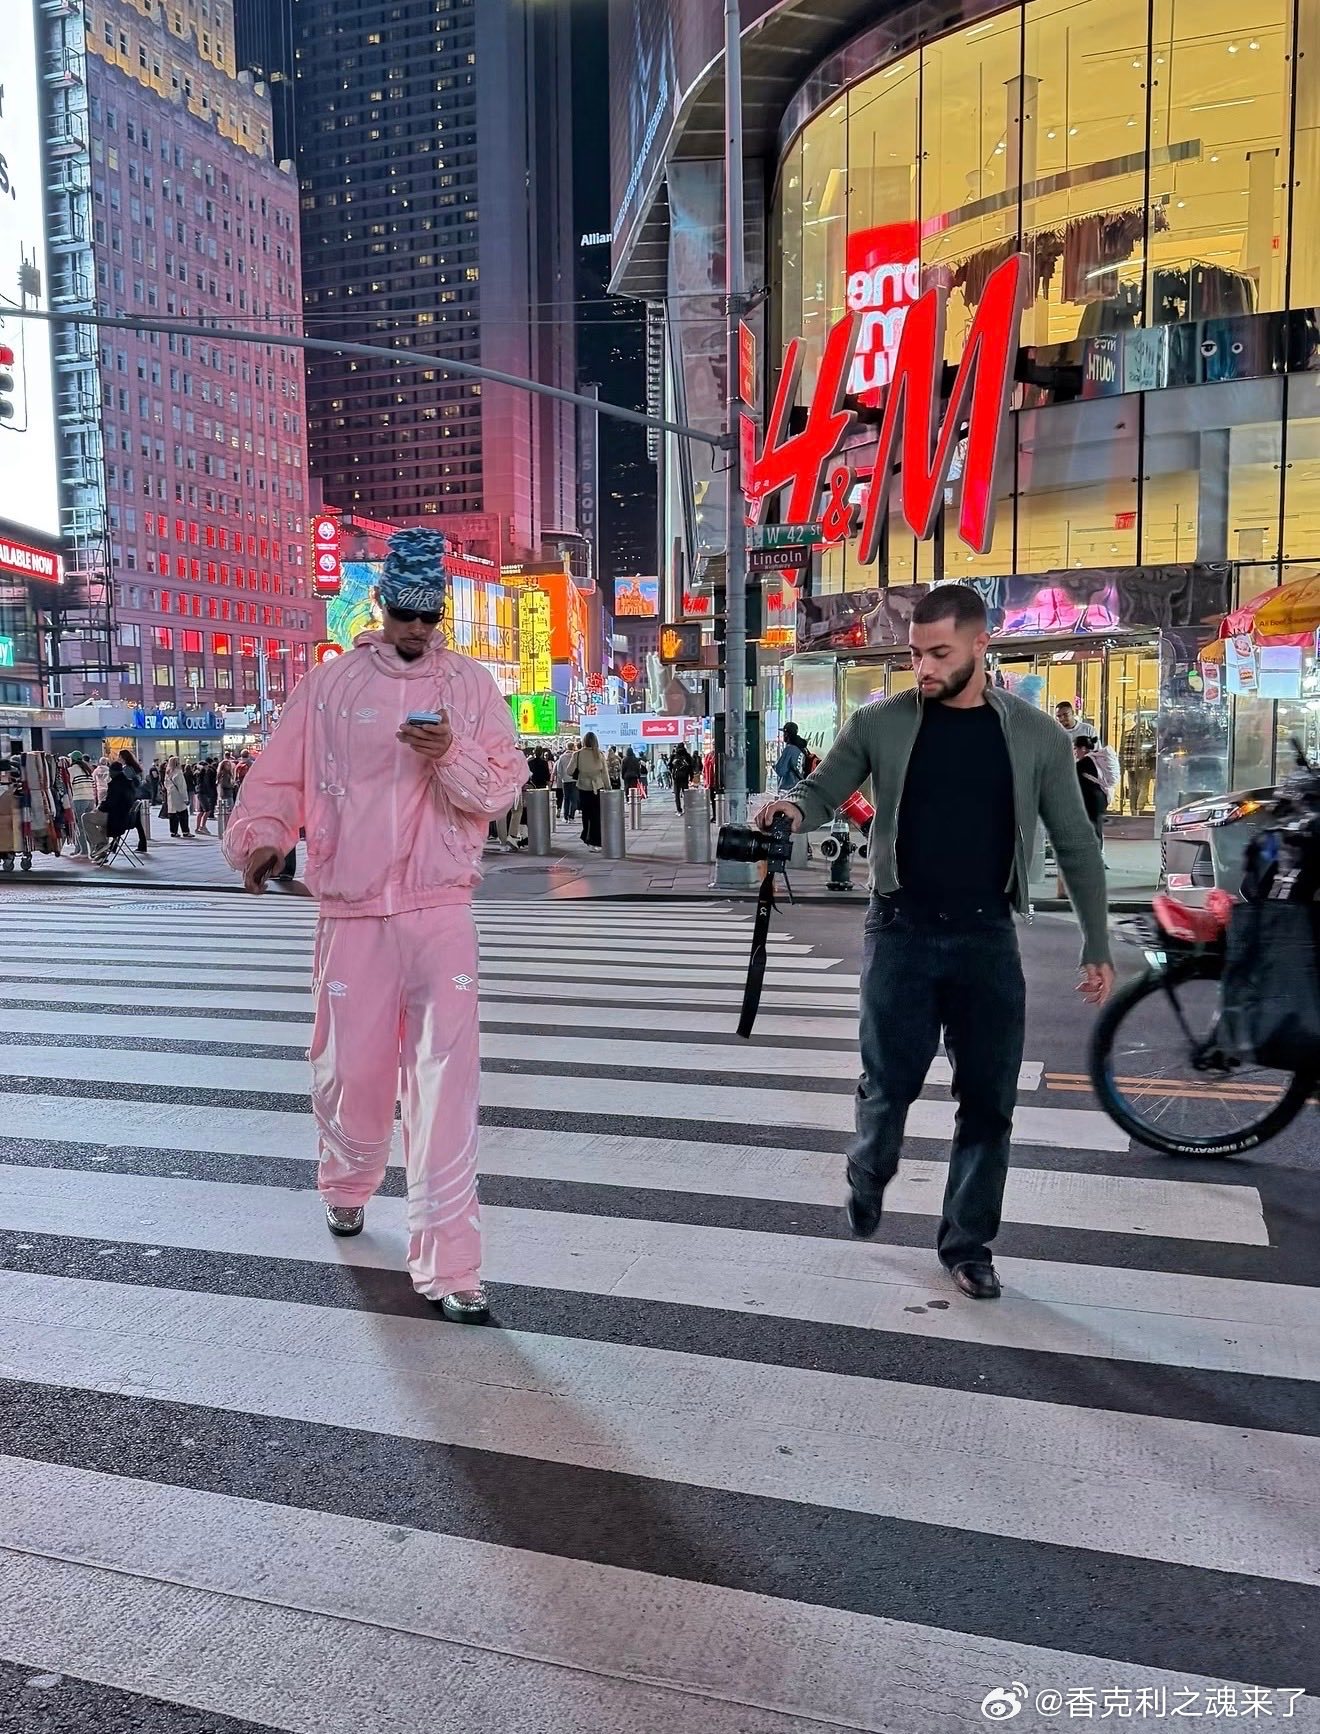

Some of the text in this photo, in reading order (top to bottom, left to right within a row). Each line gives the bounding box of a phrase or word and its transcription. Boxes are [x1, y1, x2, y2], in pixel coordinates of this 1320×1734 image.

[752, 252, 1030, 588] H&M
[766, 527, 780, 544] W
[787, 525, 804, 542] 42
[32, 553, 53, 575] NOW
[753, 550, 802, 565] Lincoln
